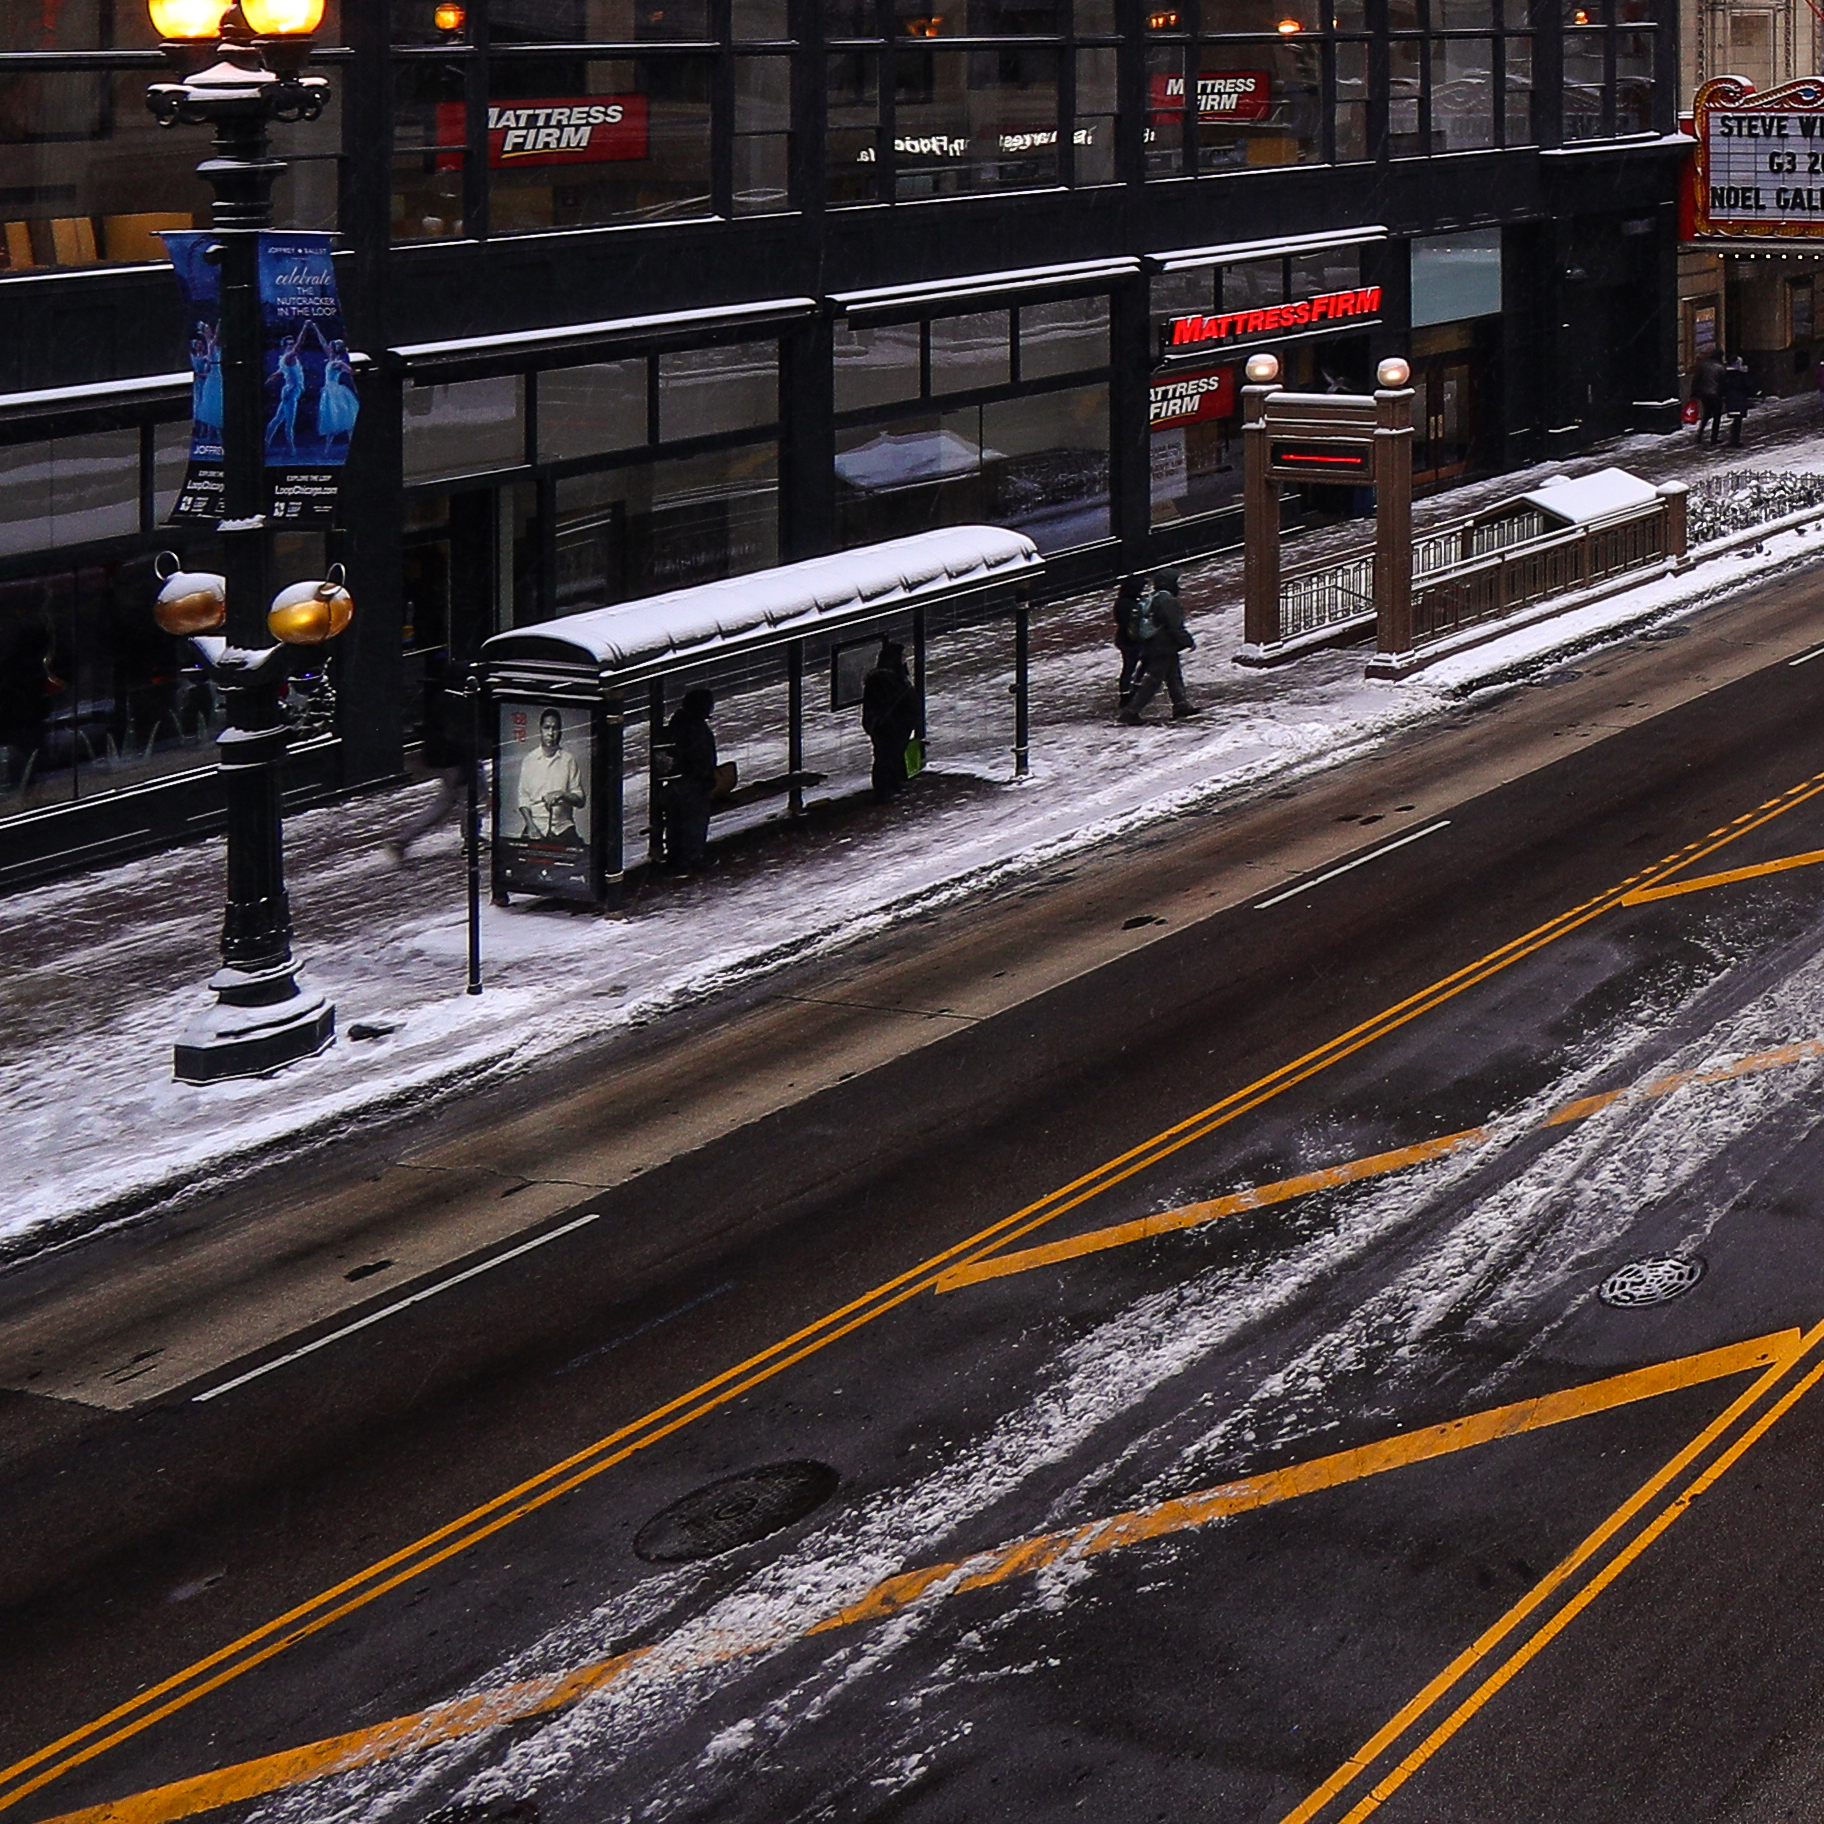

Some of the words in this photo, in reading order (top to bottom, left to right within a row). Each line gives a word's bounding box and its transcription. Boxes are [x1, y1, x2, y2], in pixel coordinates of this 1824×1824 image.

[1166, 78, 1256, 95] MTTRESS
[1197, 93, 1238, 111] IRM
[1720, 115, 1789, 139] STEVE
[503, 126, 593, 151] FIRM
[1769, 151, 1797, 175] G3
[1710, 186, 1765, 210] NOEL
[275, 266, 332, 286] celebrate
[277, 296, 336, 306] NUTCRACKER
[297, 287, 314, 296] THE
[277, 307, 289, 316] IN
[291, 307, 310, 316] THE
[312, 307, 338, 317] LOOP
[1150, 394, 1201, 420] FIRM
